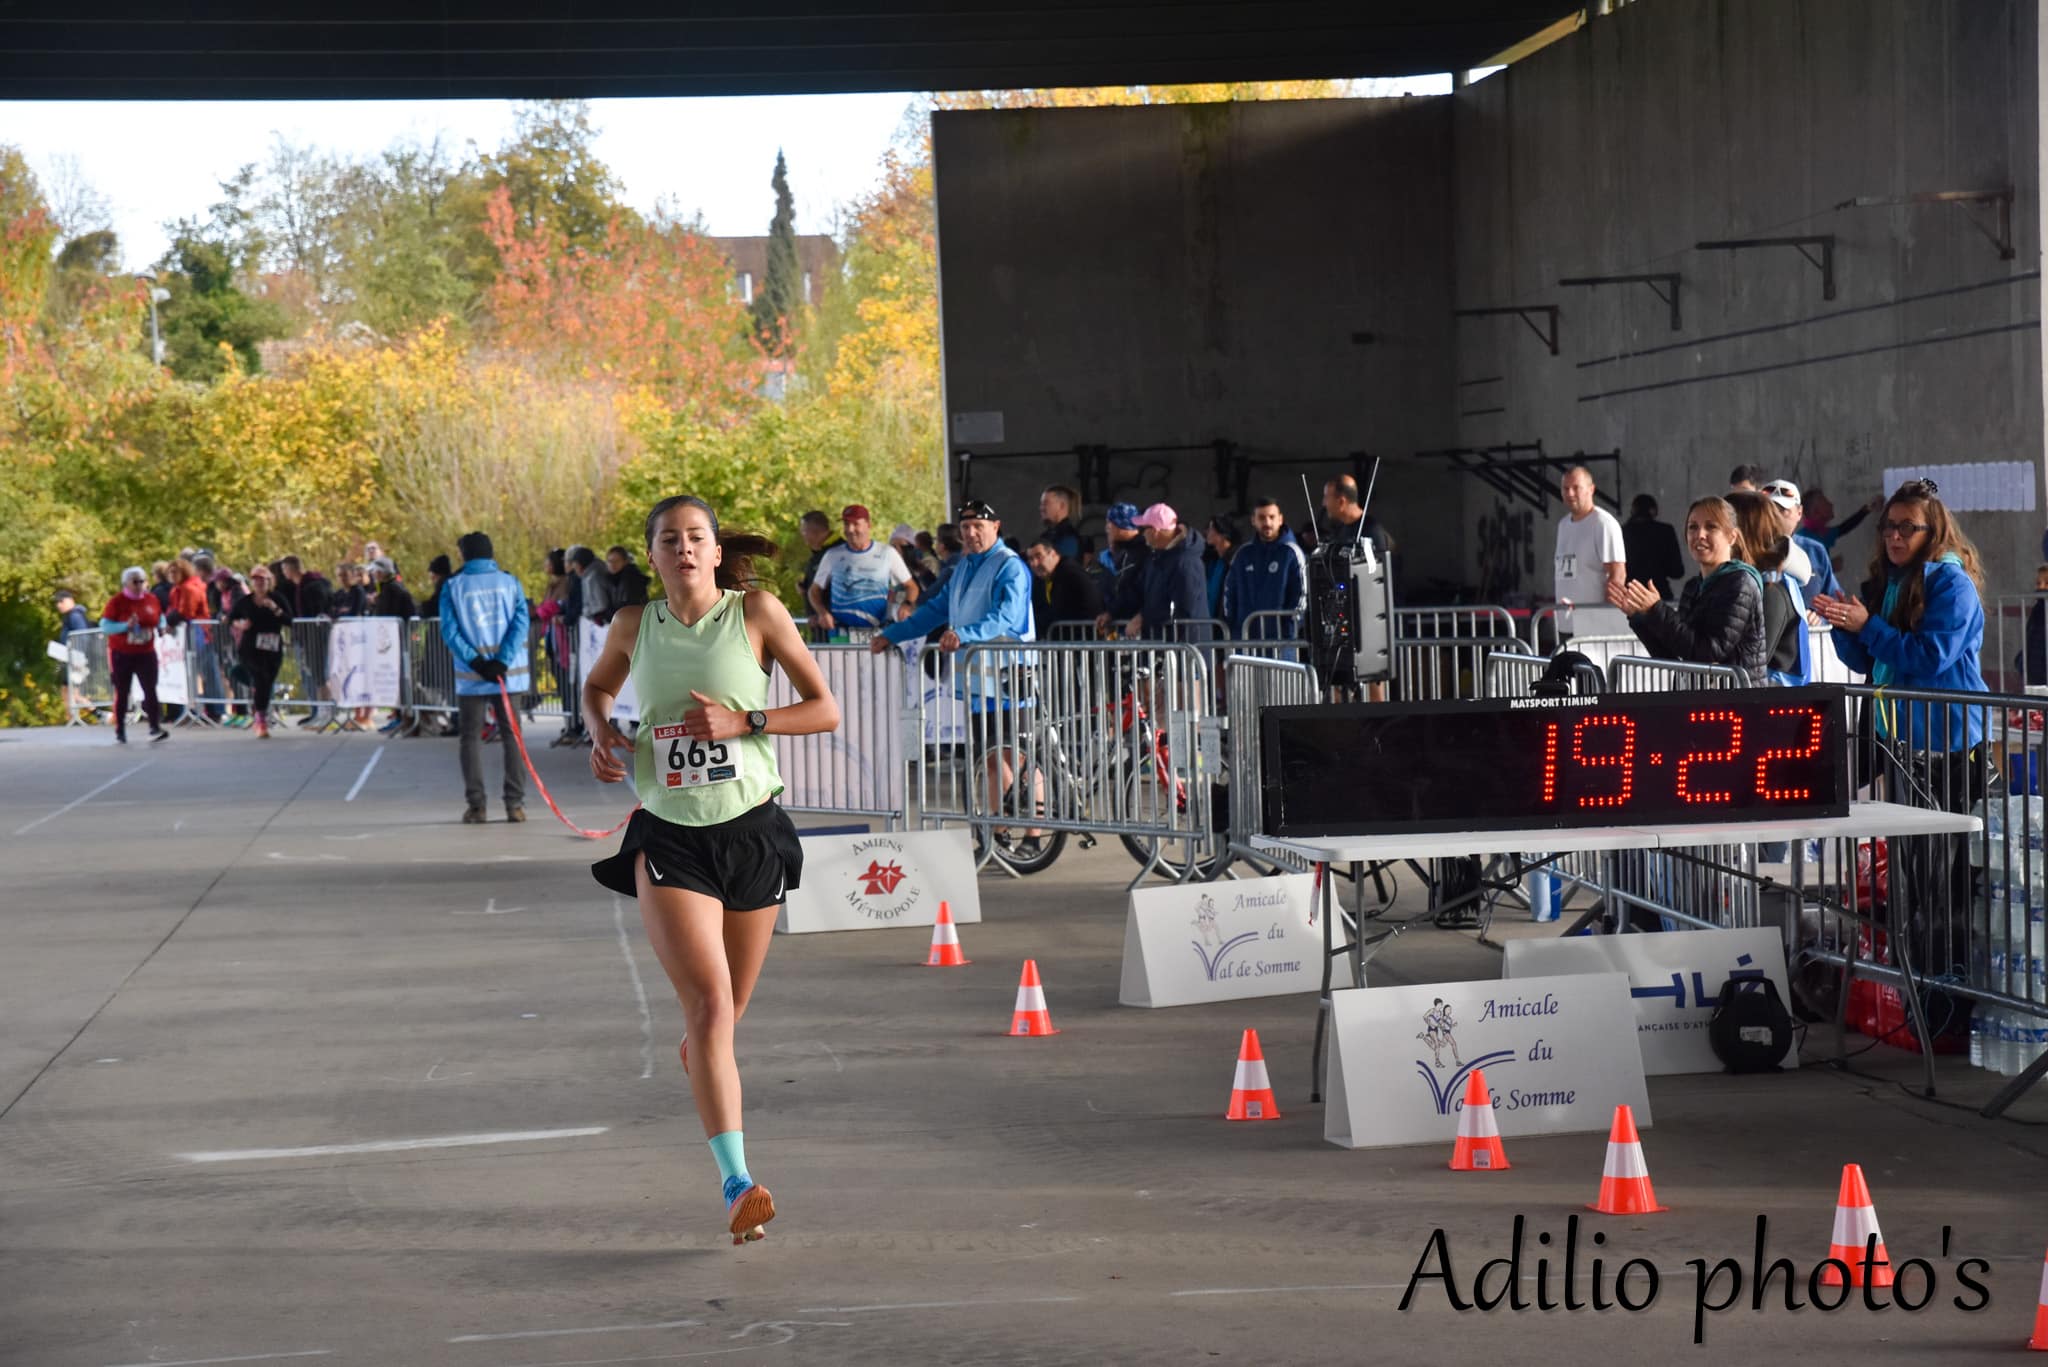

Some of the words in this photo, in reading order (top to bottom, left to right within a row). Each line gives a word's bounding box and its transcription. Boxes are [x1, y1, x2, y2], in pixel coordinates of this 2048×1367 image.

[1510, 698, 1560, 709] MATSPORT
[1561, 696, 1599, 706] TIMING
[658, 728, 676, 737] LES
[668, 739, 728, 770] 665
[852, 838, 904, 856] AMIENS
[846, 886, 921, 919] MÉTROPOLE
[1232, 888, 1287, 912] Amicale
[1267, 922, 1285, 940] du
[1236, 960, 1251, 977] de
[1254, 960, 1301, 977] Somme
[1478, 993, 1559, 1023] Amicale
[1638, 1022, 1680, 1032] ANÇAISE
[1528, 1039, 1554, 1061] du
[1506, 1089, 1576, 1111] Somme
